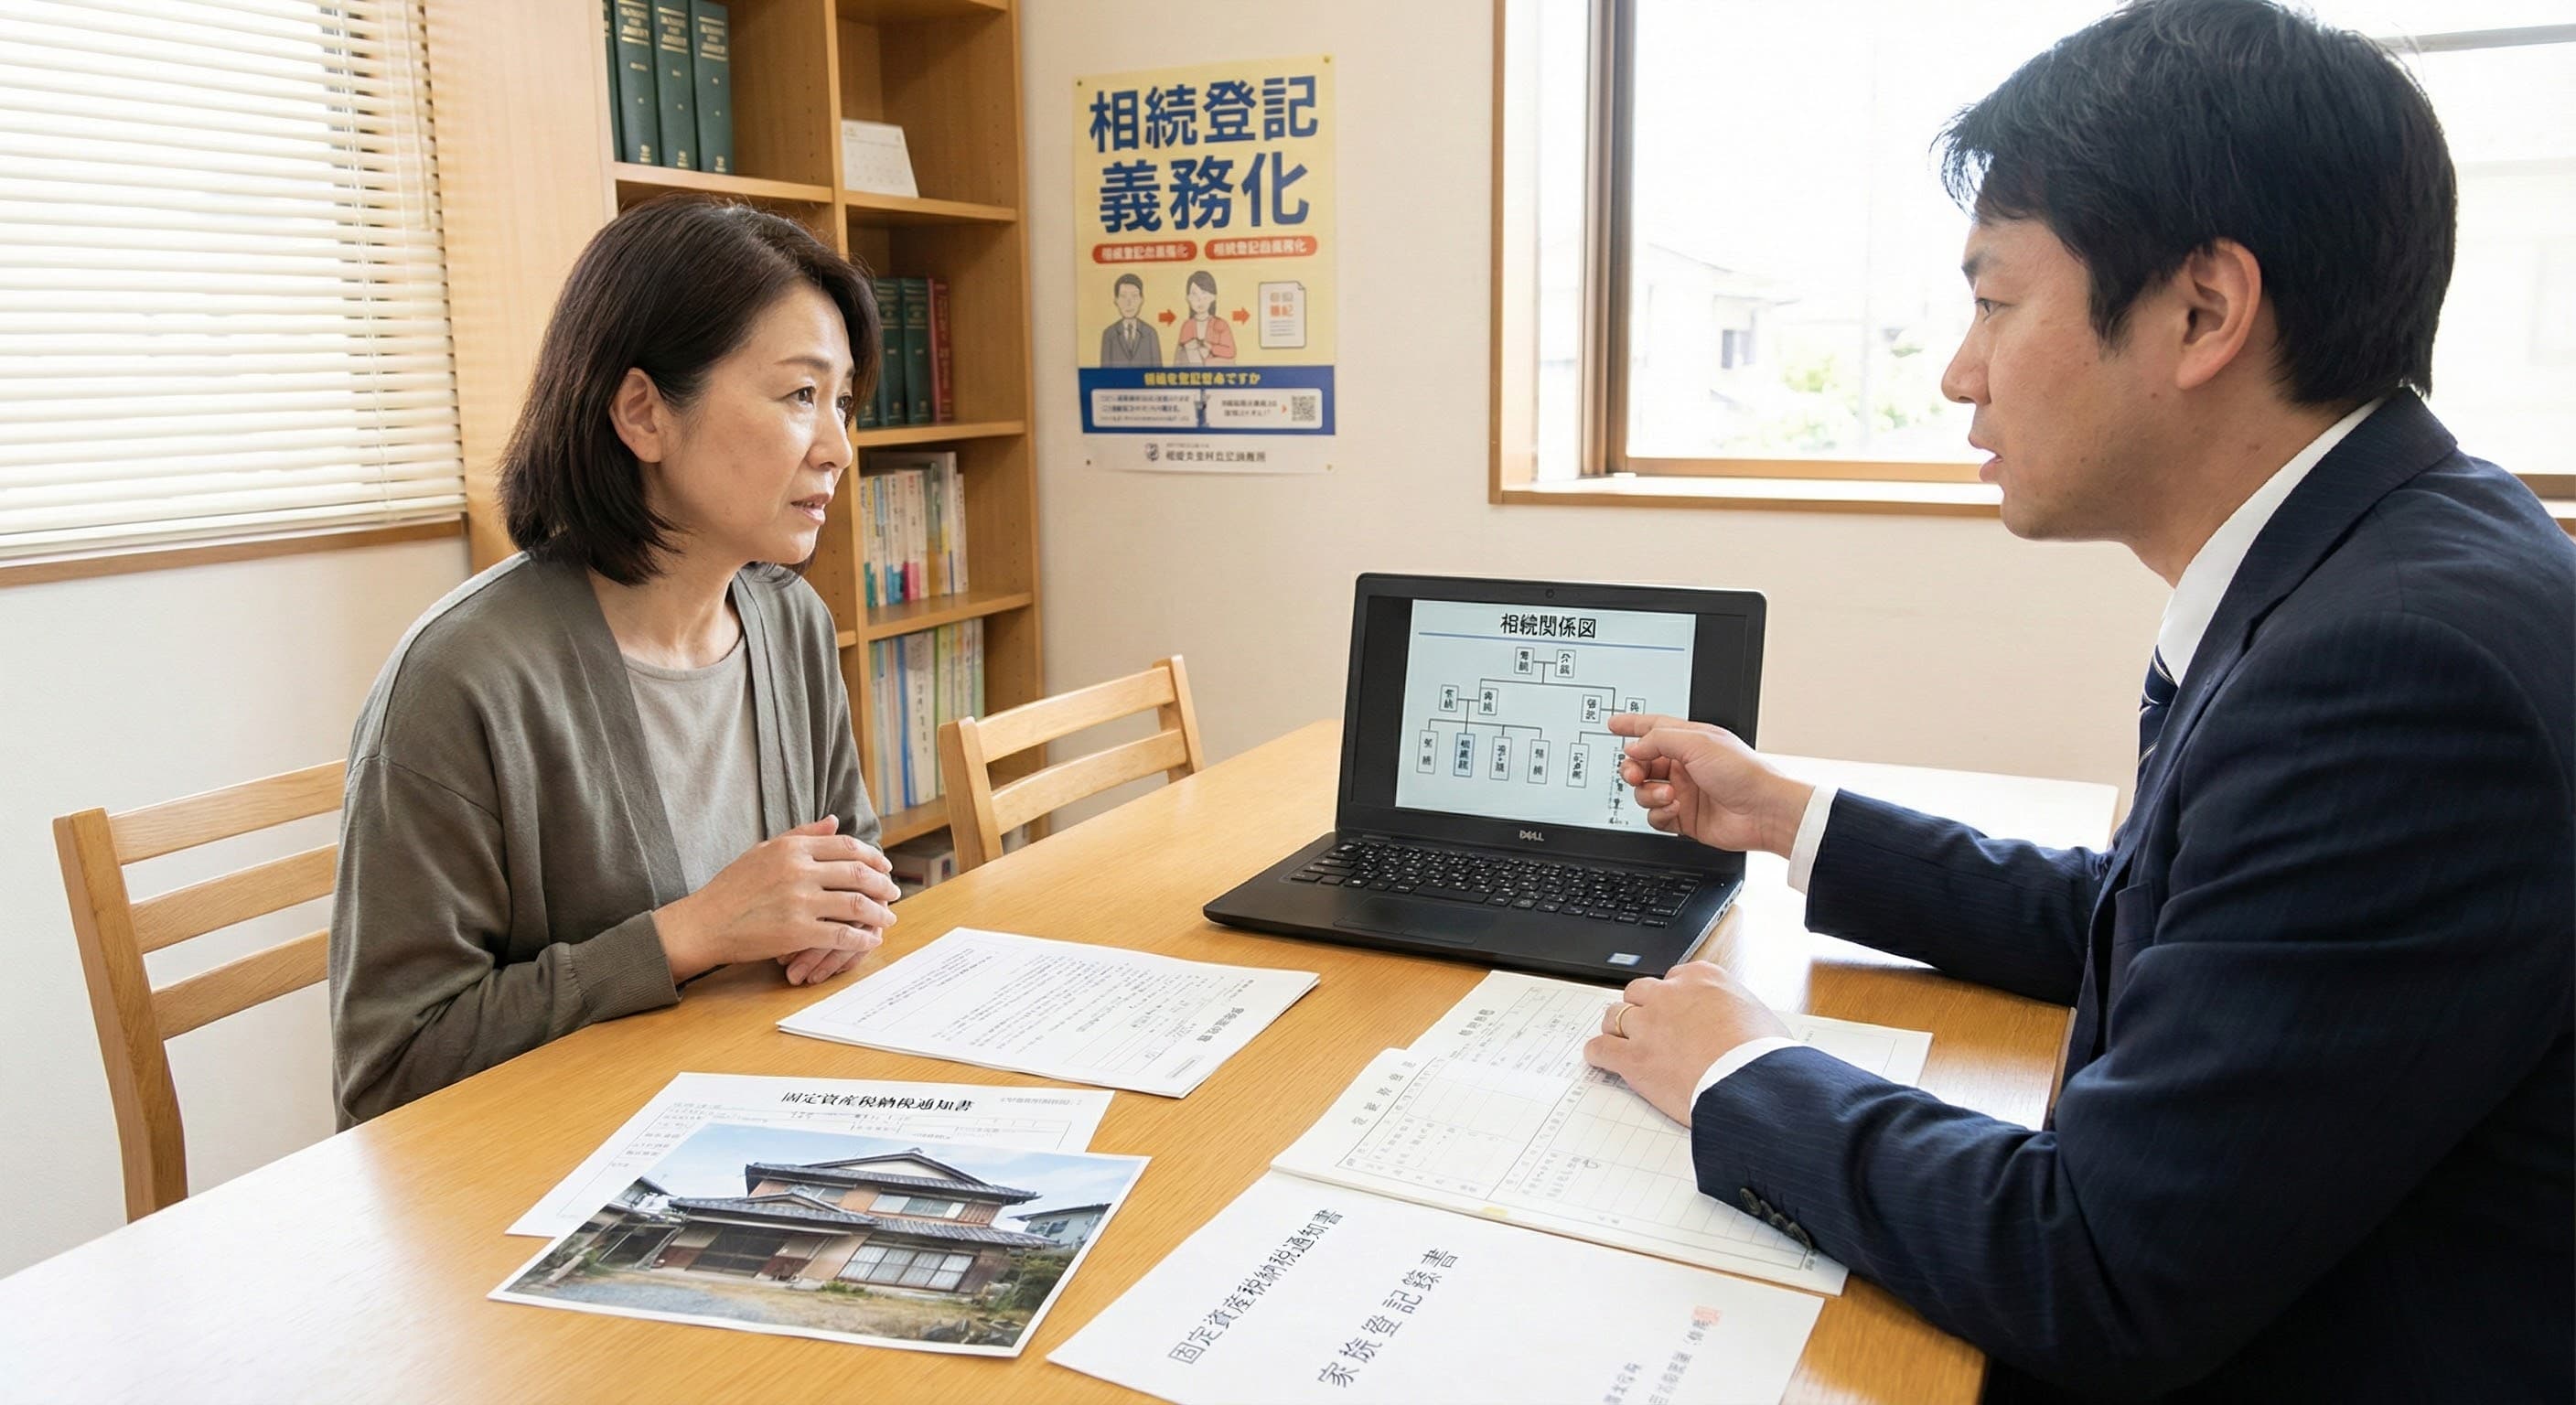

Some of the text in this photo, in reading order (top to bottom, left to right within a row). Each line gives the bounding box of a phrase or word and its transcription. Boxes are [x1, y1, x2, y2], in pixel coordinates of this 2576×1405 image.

[1089, 76, 1319, 153] 相続登記
[1100, 151, 1310, 233] 義務化
[1500, 613, 1596, 638] 相続関係図
[1519, 830, 1545, 842] DELL
[1167, 1208, 1344, 1365] 固定資産税納税通知書
